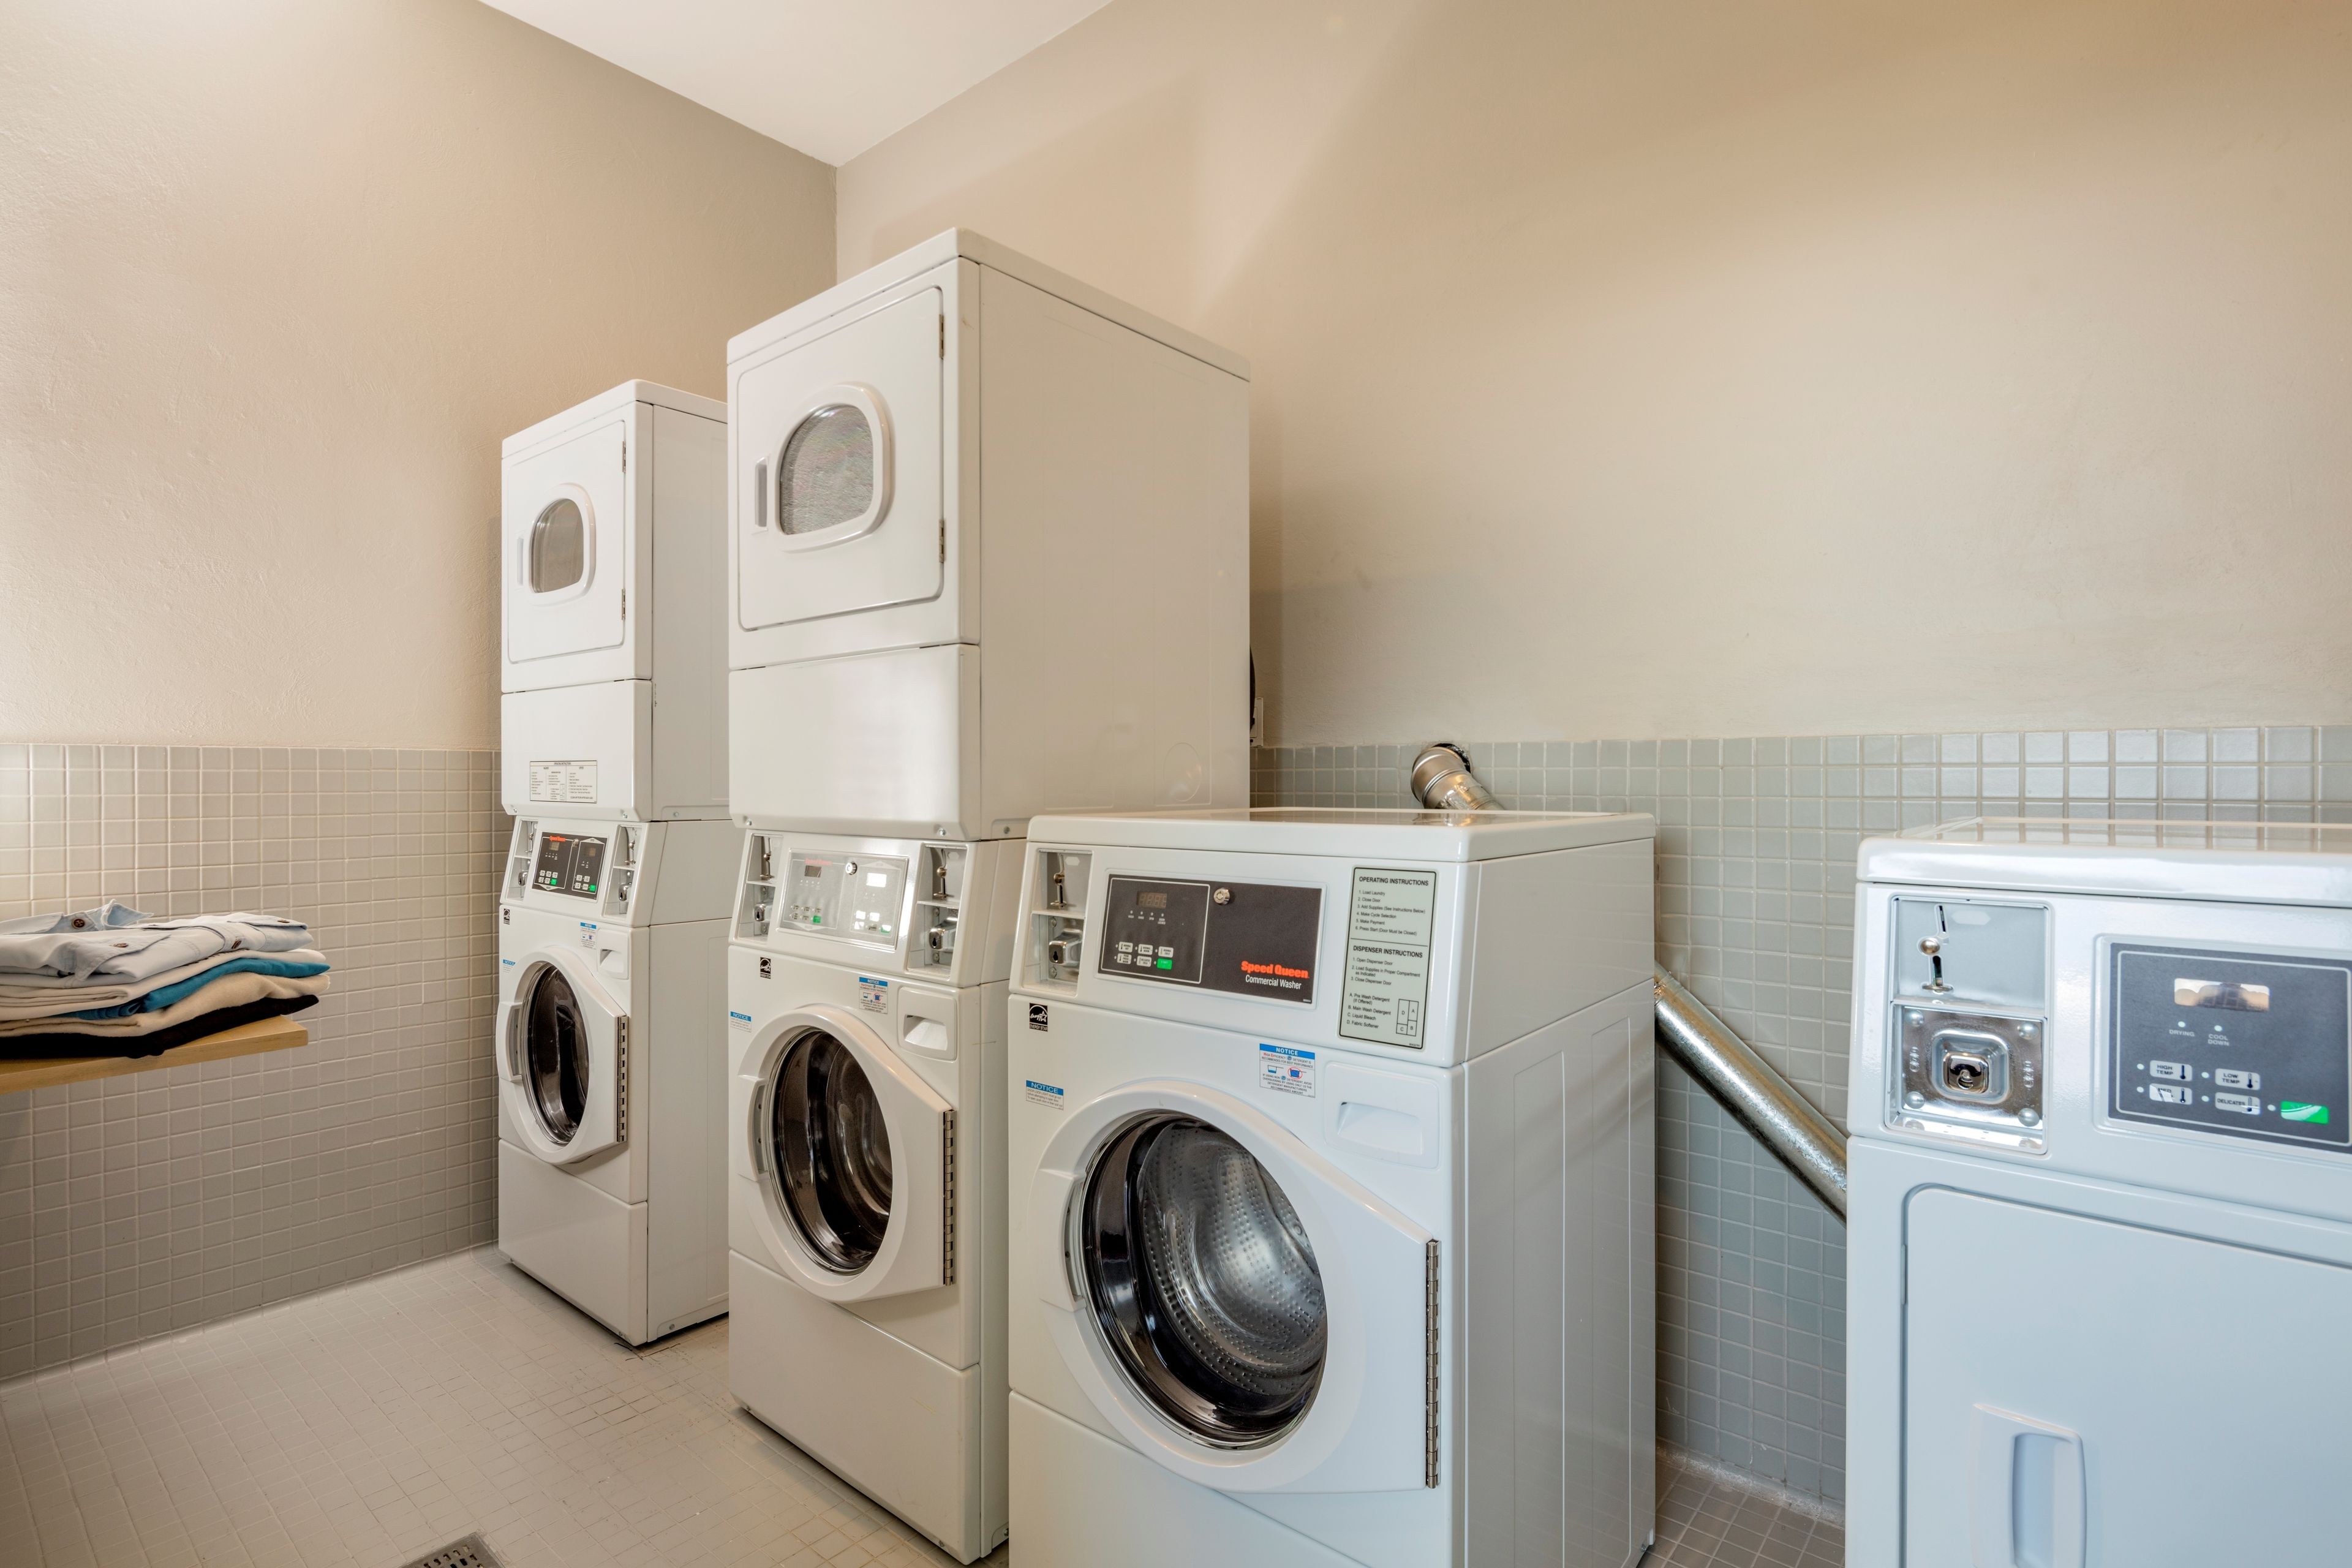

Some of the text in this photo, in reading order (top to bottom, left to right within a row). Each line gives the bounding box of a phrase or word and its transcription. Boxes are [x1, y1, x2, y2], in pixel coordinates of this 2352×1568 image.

[1353, 945, 1423, 958] DISPENSER INSTRUCTIONS
[1241, 960, 1309, 979] Speed Queen
[1245, 974, 1302, 990] Commercial Washer
[1276, 1047, 1298, 1056] NOTICE
[1031, 1082, 1058, 1094] NOTICE
